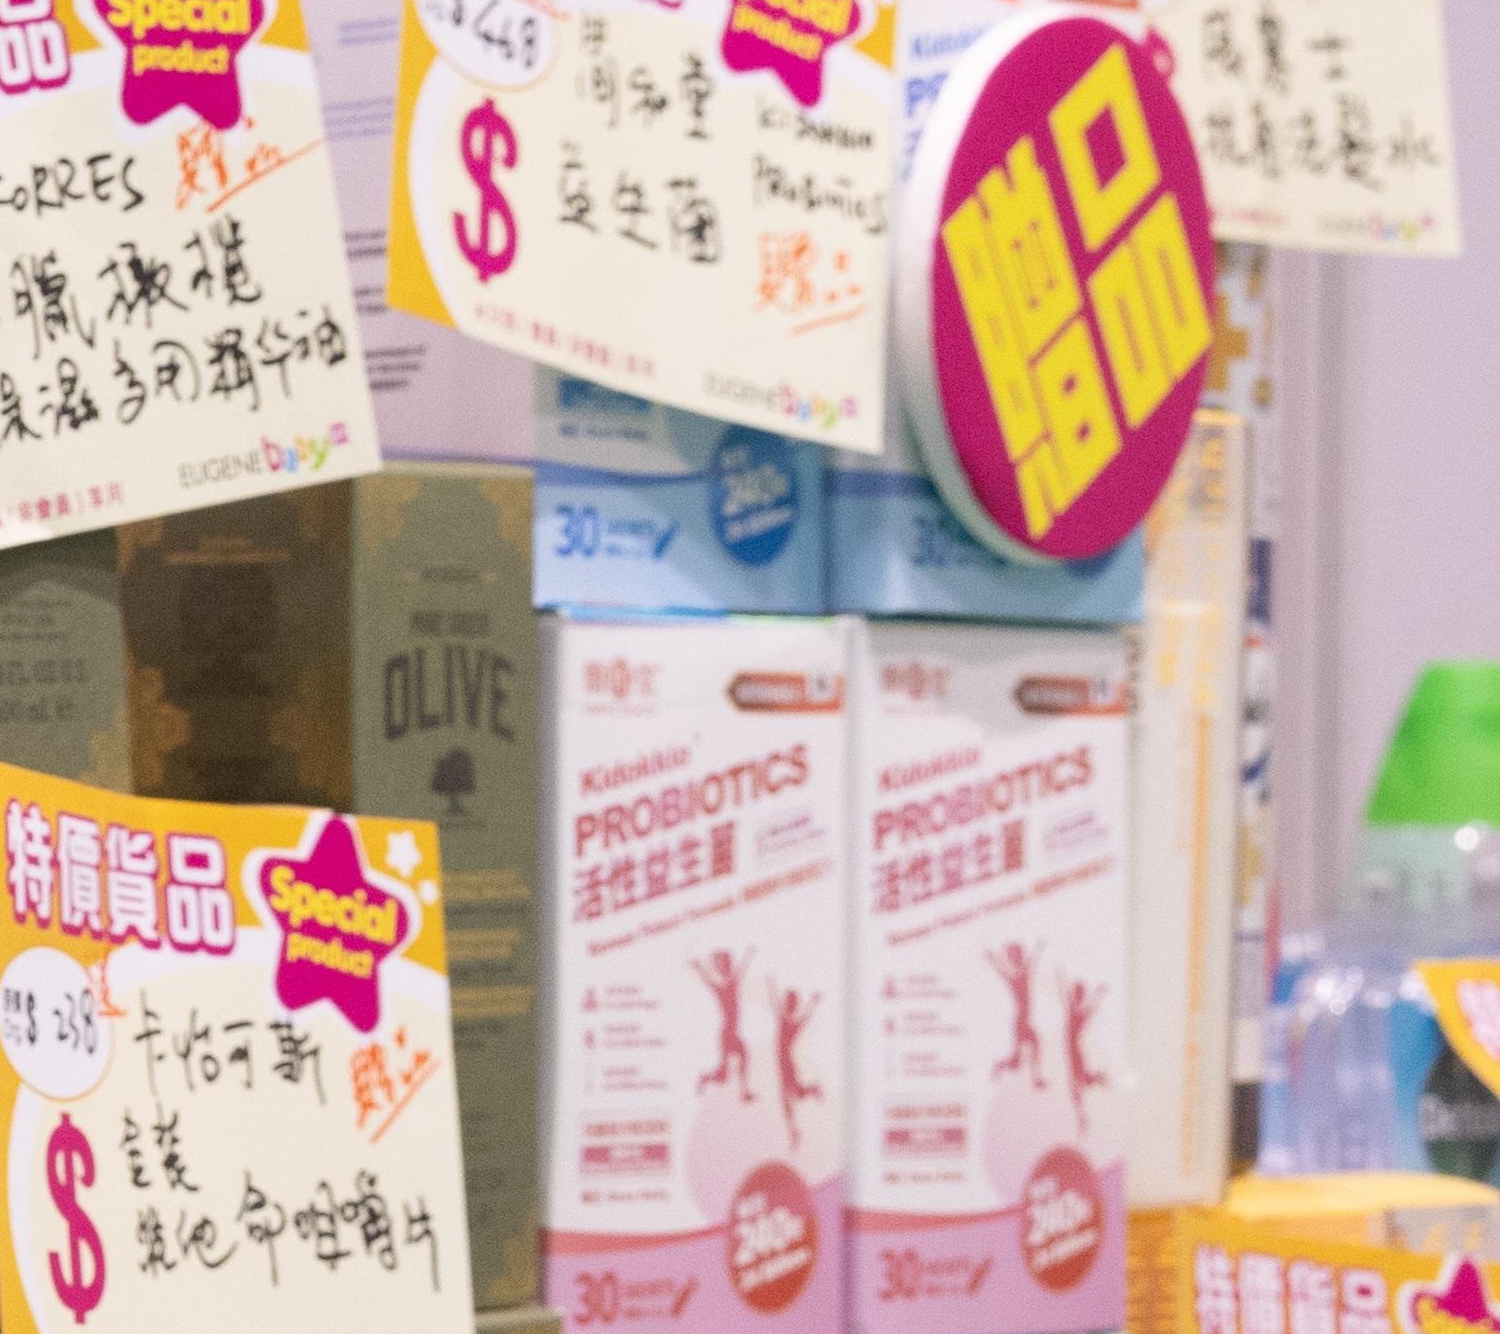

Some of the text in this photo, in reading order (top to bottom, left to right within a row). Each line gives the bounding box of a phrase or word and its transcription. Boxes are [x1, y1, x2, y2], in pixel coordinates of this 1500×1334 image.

[942, 43, 1214, 542] 贈品
[572, 743, 812, 859] PROBIOTICS
[870, 743, 1096, 854] PROBIOTICS
[5, 798, 236, 954] 特價貨品
